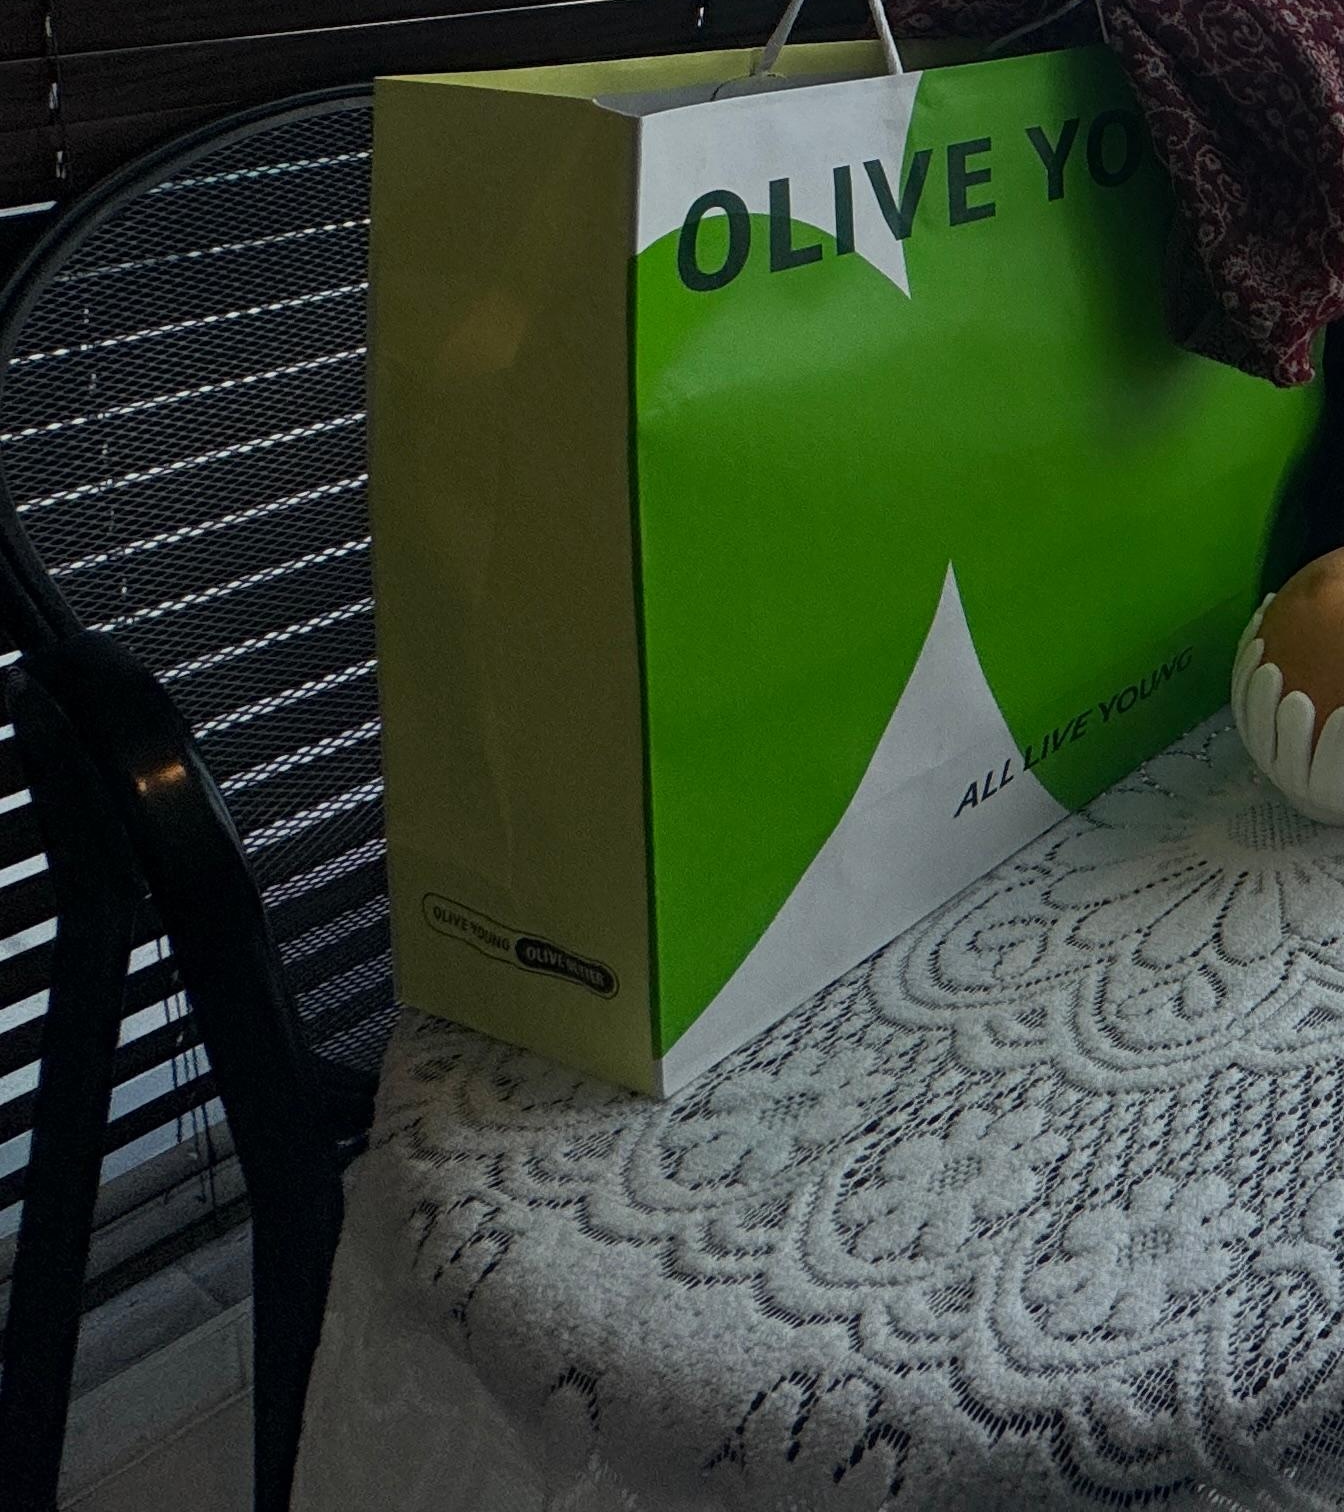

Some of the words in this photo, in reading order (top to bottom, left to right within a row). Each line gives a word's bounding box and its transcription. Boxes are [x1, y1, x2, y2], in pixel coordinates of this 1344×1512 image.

[677, 137, 997, 292] OLIVE
[954, 758, 1014, 818] ALL
[1023, 709, 1092, 772] LIVE
[1098, 646, 1193, 723] YOUNG
[433, 905, 471, 932] OLIVE
[469, 922, 510, 951] YOUNG
[526, 946, 566, 969] OLIVE
